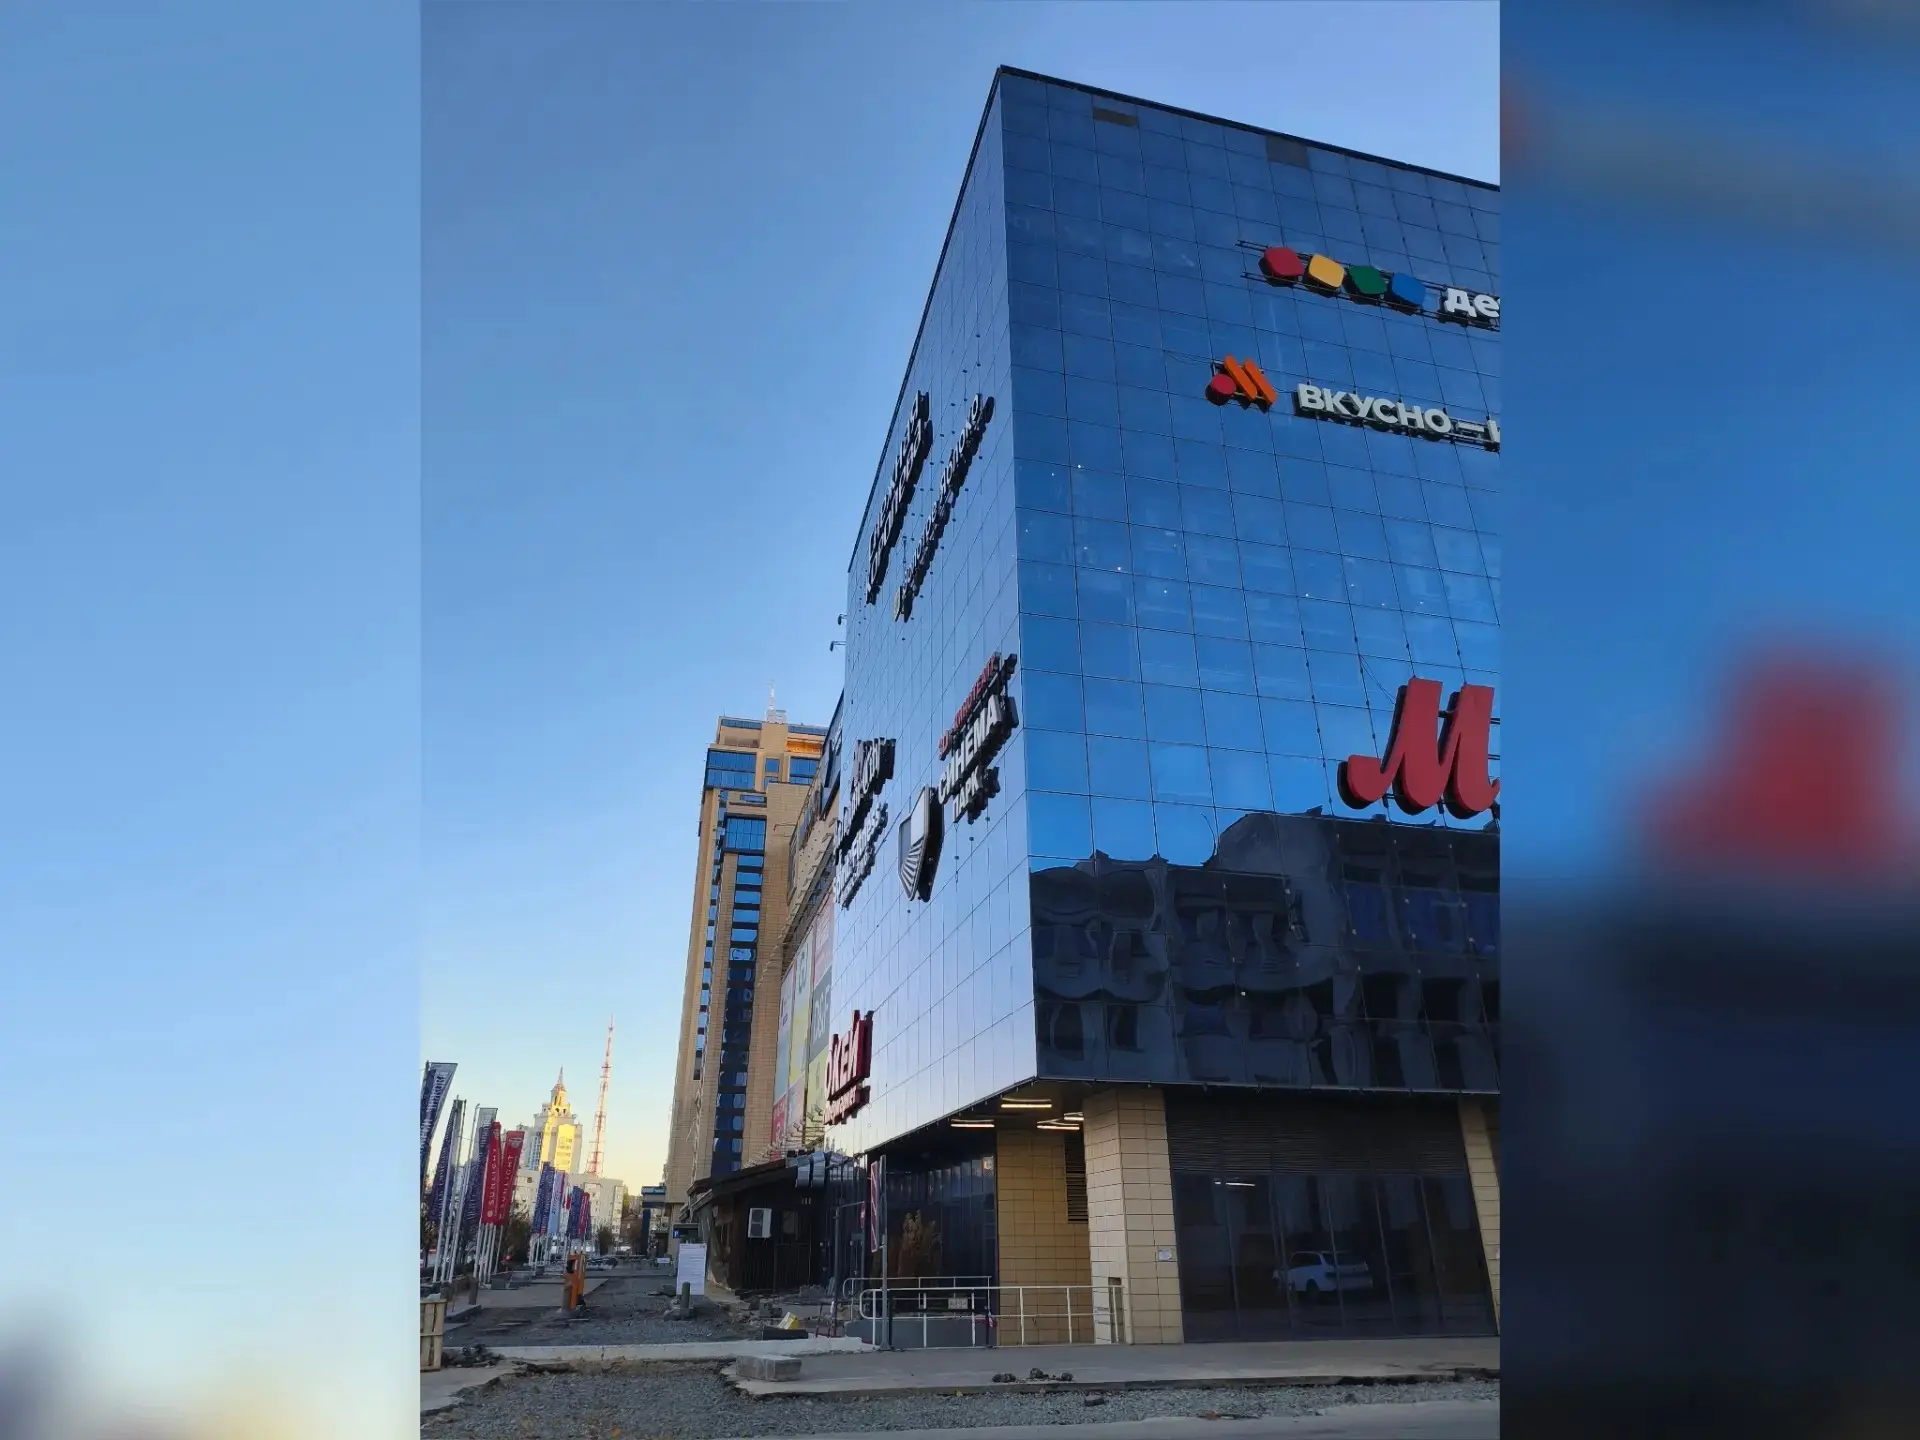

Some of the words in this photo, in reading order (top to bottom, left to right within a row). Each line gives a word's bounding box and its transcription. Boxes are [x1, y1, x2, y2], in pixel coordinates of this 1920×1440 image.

[1444, 288, 1500, 318] де
[1297, 383, 1452, 434] ВКУСНО
[937, 694, 1001, 805] СИНЕМА
[953, 764, 981, 823] ПАРК
